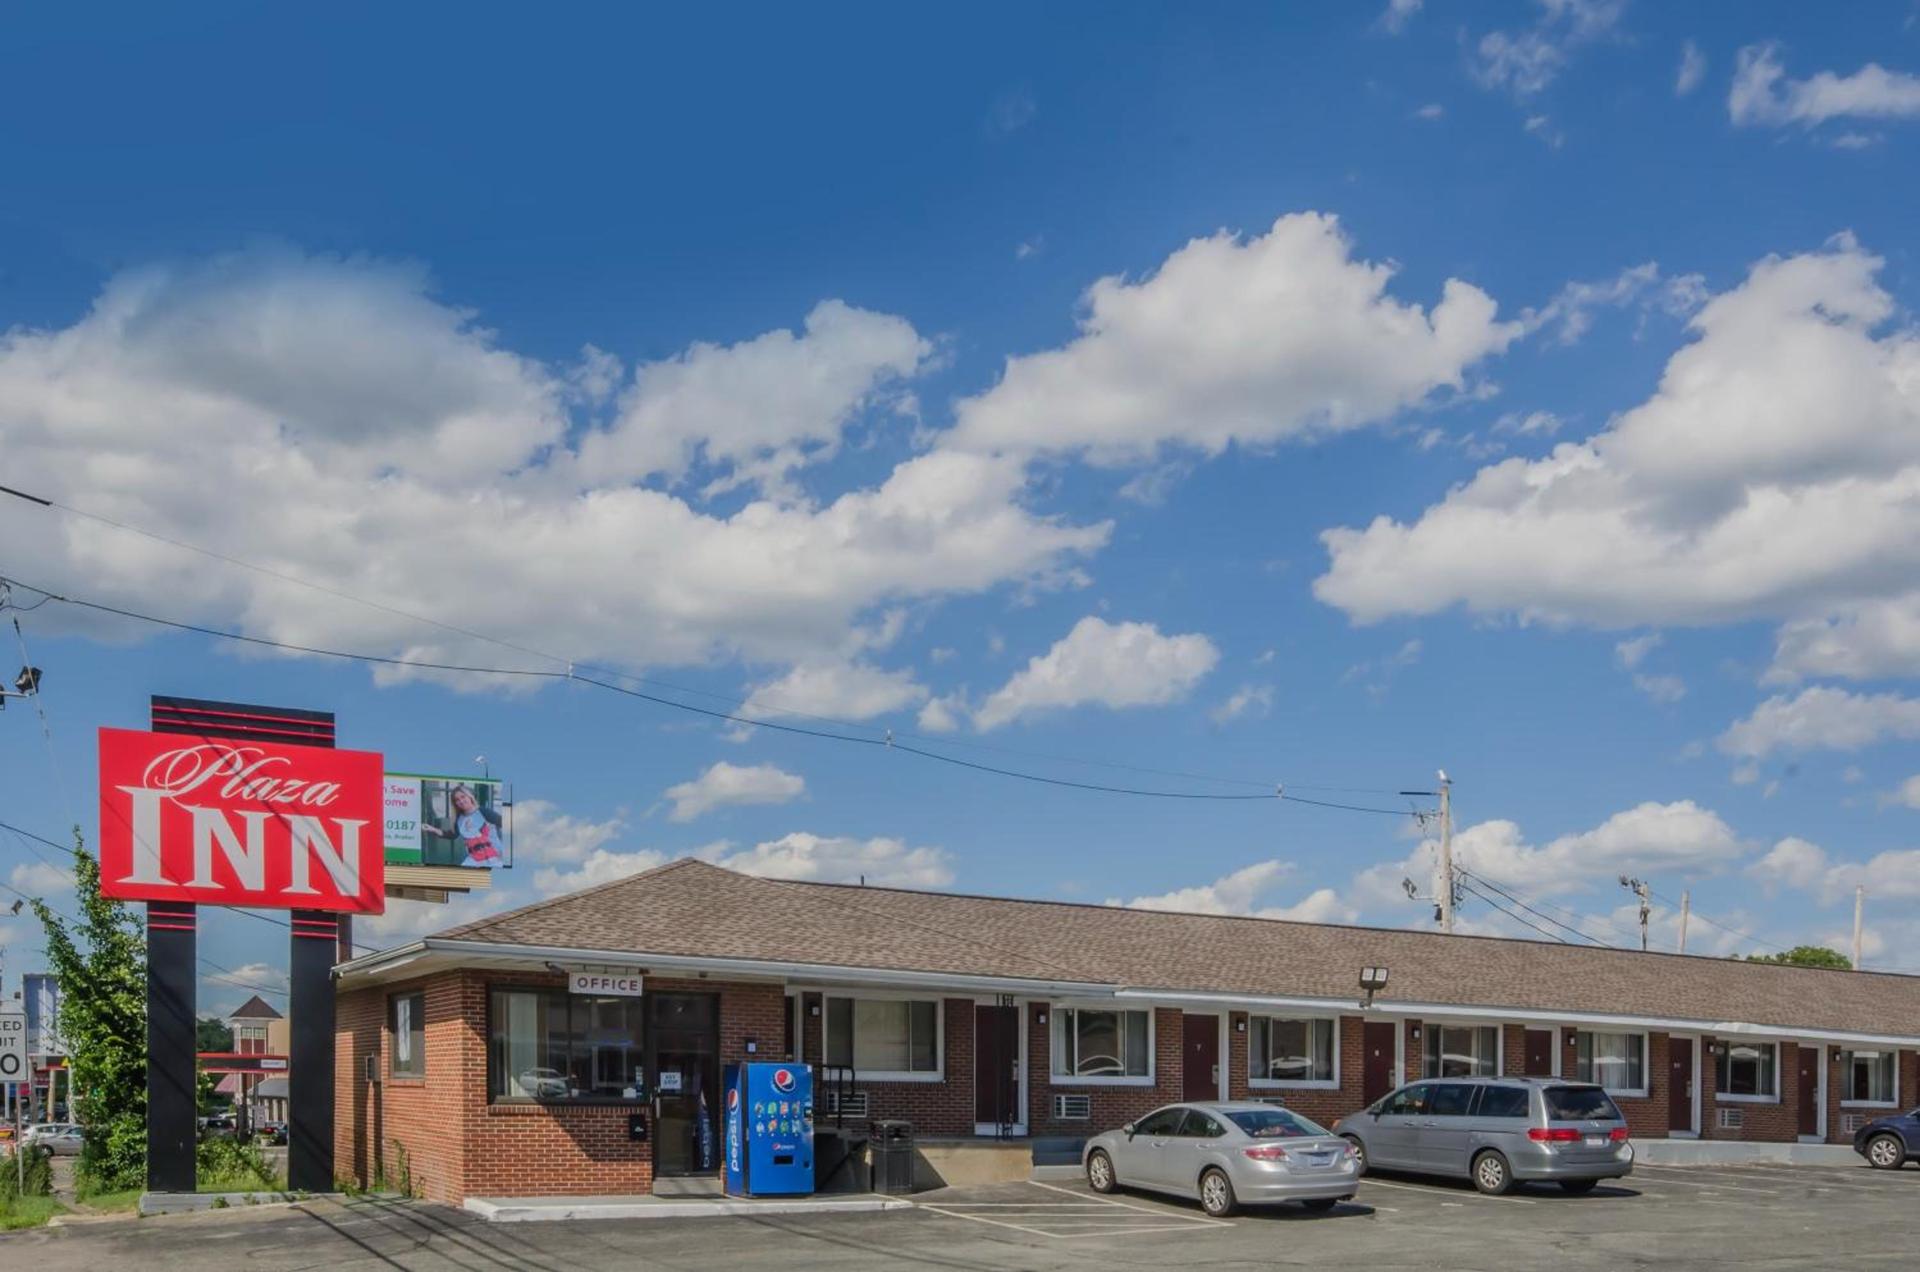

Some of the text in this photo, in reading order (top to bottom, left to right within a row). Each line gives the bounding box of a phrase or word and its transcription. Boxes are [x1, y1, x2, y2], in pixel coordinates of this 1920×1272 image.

[143, 744, 342, 807] Plaza
[391, 784, 416, 795] Save
[384, 799, 408, 808] ome
[386, 819, 416, 832] 0187
[115, 785, 370, 897] INN
[577, 977, 639, 991] OFFICE
[0, 1021, 22, 1031] ED
[1, 1053, 20, 1075] 0
[729, 1119, 740, 1172] pepsi
